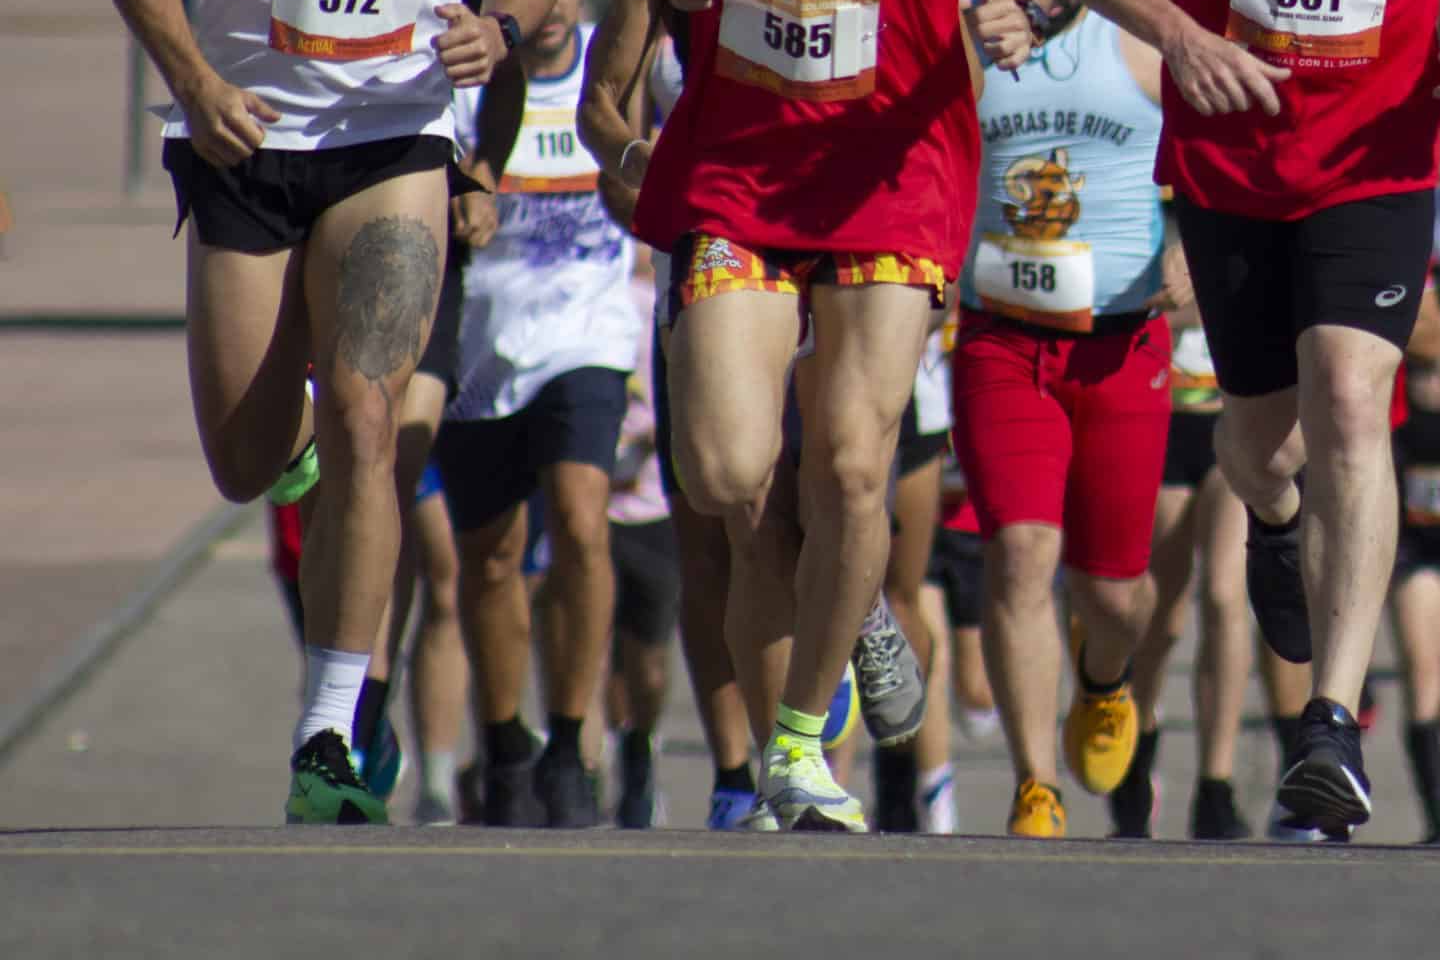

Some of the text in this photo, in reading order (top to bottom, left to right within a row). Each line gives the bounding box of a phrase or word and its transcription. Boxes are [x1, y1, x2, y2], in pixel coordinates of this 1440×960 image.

[764, 12, 833, 58] 585
[1297, 56, 1321, 67] CON
[1324, 58, 1335, 68] EL
[536, 130, 576, 158] 110
[1054, 109, 1077, 135] DE
[1080, 112, 1135, 147] RIVAS
[1009, 260, 1057, 292] 158
